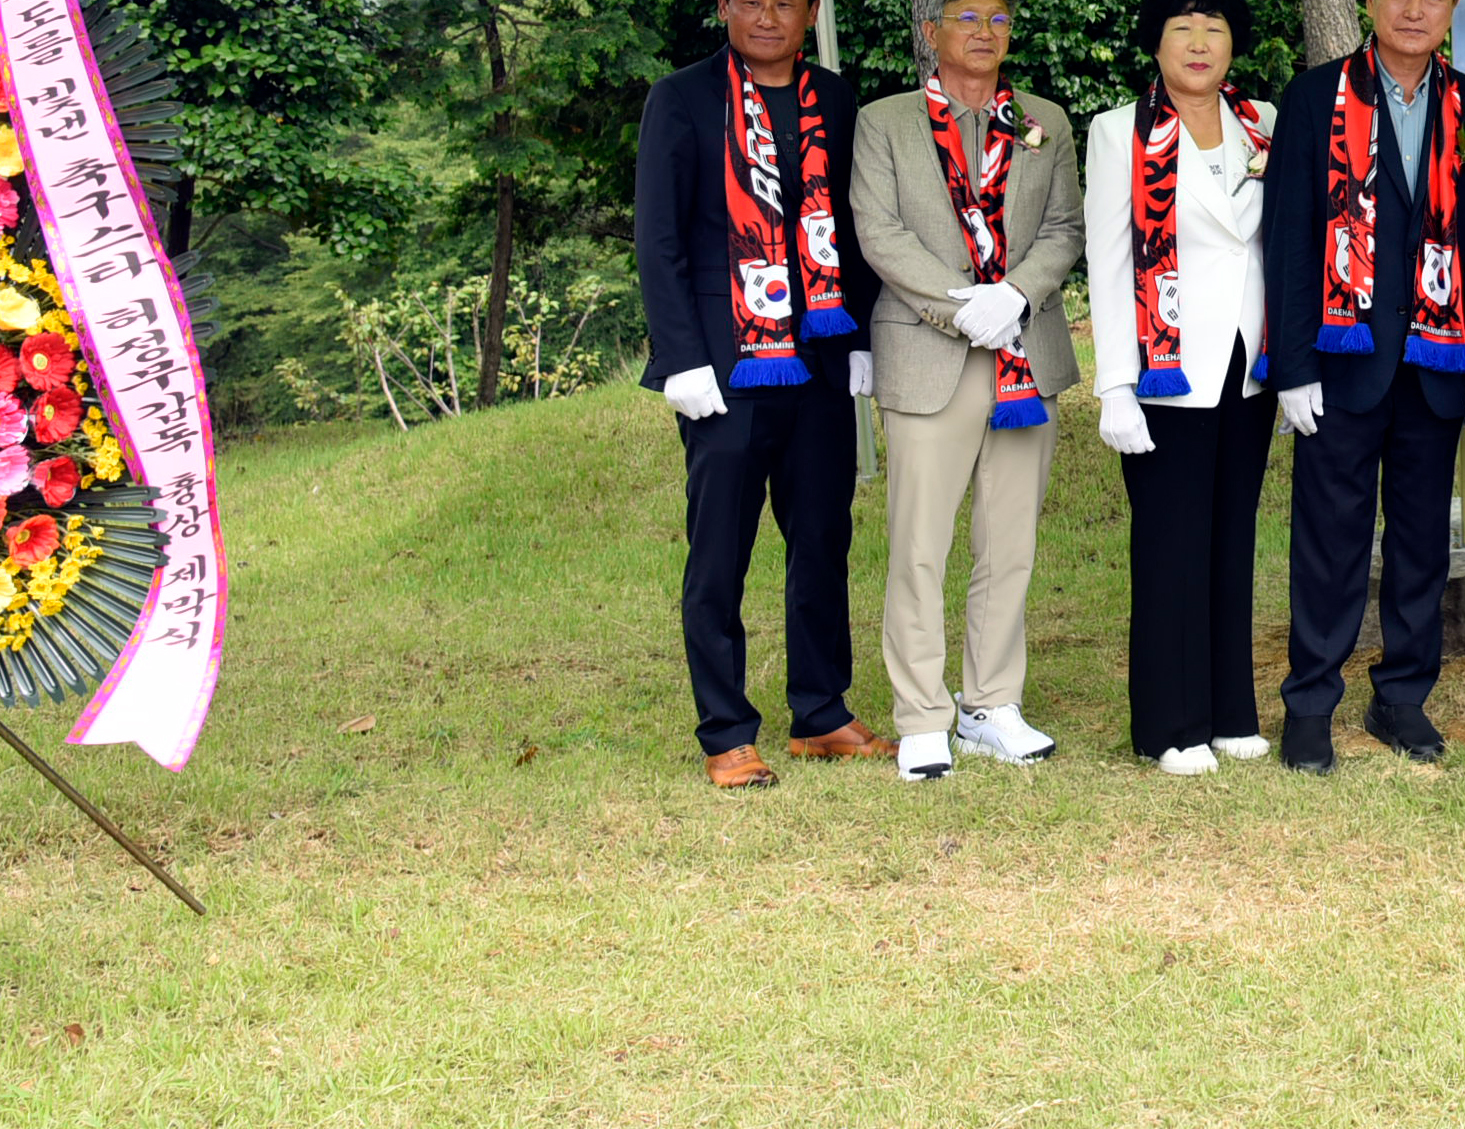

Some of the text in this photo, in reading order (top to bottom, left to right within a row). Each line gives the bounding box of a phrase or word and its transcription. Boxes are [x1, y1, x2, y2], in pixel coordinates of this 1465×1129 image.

[23, 77, 91, 142] 빛낸
[49, 157, 159, 284] 축구스타
[147, 554, 217, 650] 제막식
